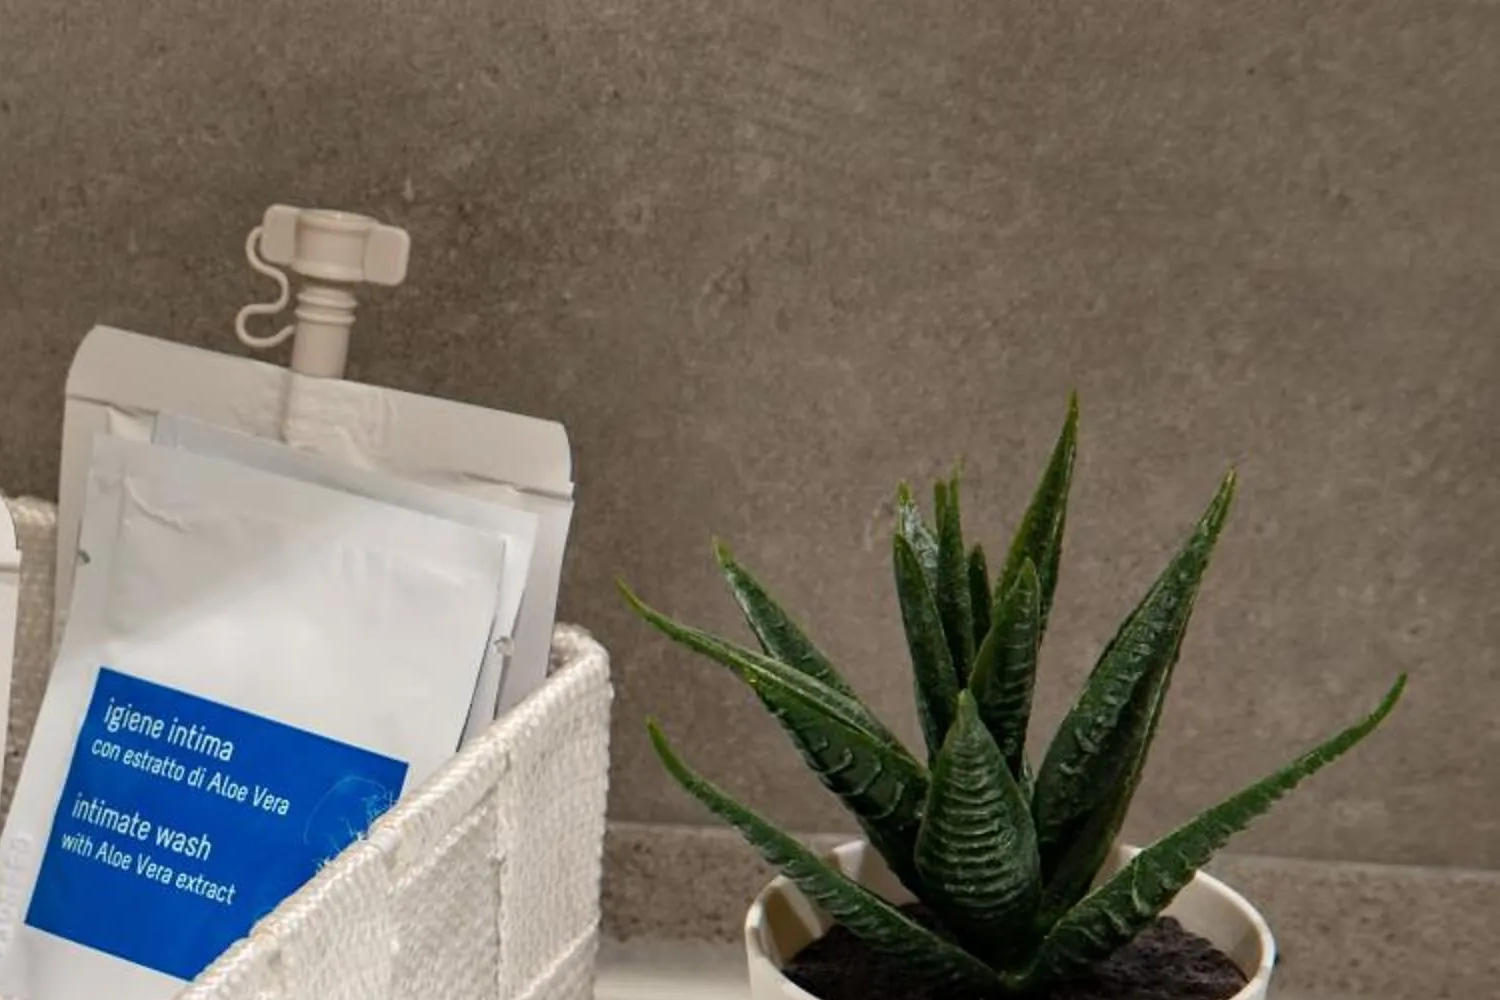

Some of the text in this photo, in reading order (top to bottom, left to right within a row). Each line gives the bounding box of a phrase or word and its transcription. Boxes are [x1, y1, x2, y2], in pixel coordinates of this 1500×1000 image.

[104, 699, 234, 762] igiene intima
[90, 737, 291, 816] con estratto di Aloe Vera
[72, 792, 212, 860] intimate wash
[60, 831, 237, 906] with Aloe Vera extract
